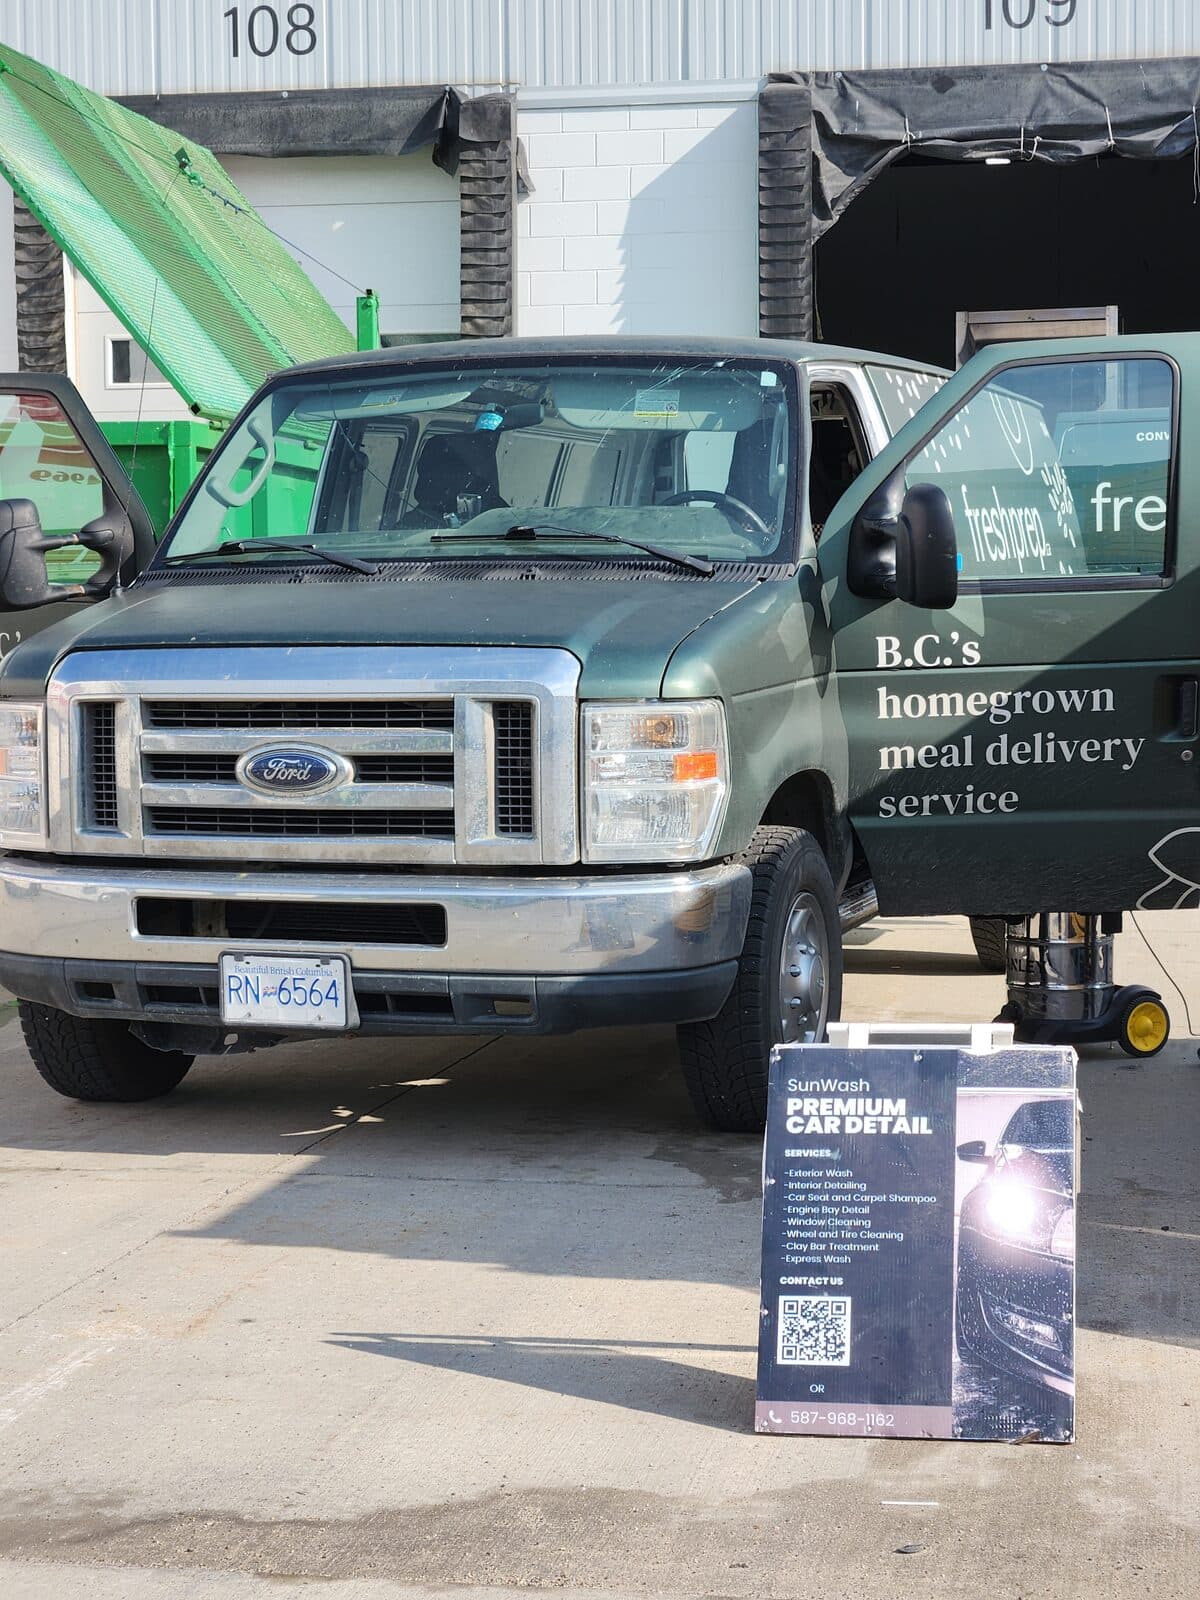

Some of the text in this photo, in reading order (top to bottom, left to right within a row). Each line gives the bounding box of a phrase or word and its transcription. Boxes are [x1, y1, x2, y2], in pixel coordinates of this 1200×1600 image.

[223, 3, 317, 58] 108
[1090, 481, 1167, 532] fre
[875, 631, 982, 668] B.C.'s
[876, 686, 1115, 724] homegrown
[878, 732, 1146, 770] meal delivery
[263, 758, 312, 781] Ford
[878, 784, 1020, 818] service
[234, 965, 333, 977] Beautiful British Columbia
[787, 1078, 870, 1092] SunWash
[786, 1098, 906, 1116] PREMIUM
[785, 1116, 933, 1135] CAR DETAIL
[784, 1148, 832, 1158] SERVICES
[784, 1169, 853, 1178] -Exterior Wash
[783, 1181, 867, 1191] -Interior Detailing
[783, 1193, 937, 1205] -Car Seat and Carpet Shampoo
[782, 1206, 870, 1215] -Engine Bay Detail
[782, 1218, 872, 1228] -Window Cleaning
[781, 1230, 904, 1241] -Wheel and Tire Cleaning
[781, 1242, 880, 1252] -Clay Bar Treatment
[780, 1254, 851, 1264] -Express Wash
[779, 1276, 844, 1286] CONTACT US
[809, 1384, 825, 1393] OR
[790, 1410, 895, 1427] 587-968-1162
